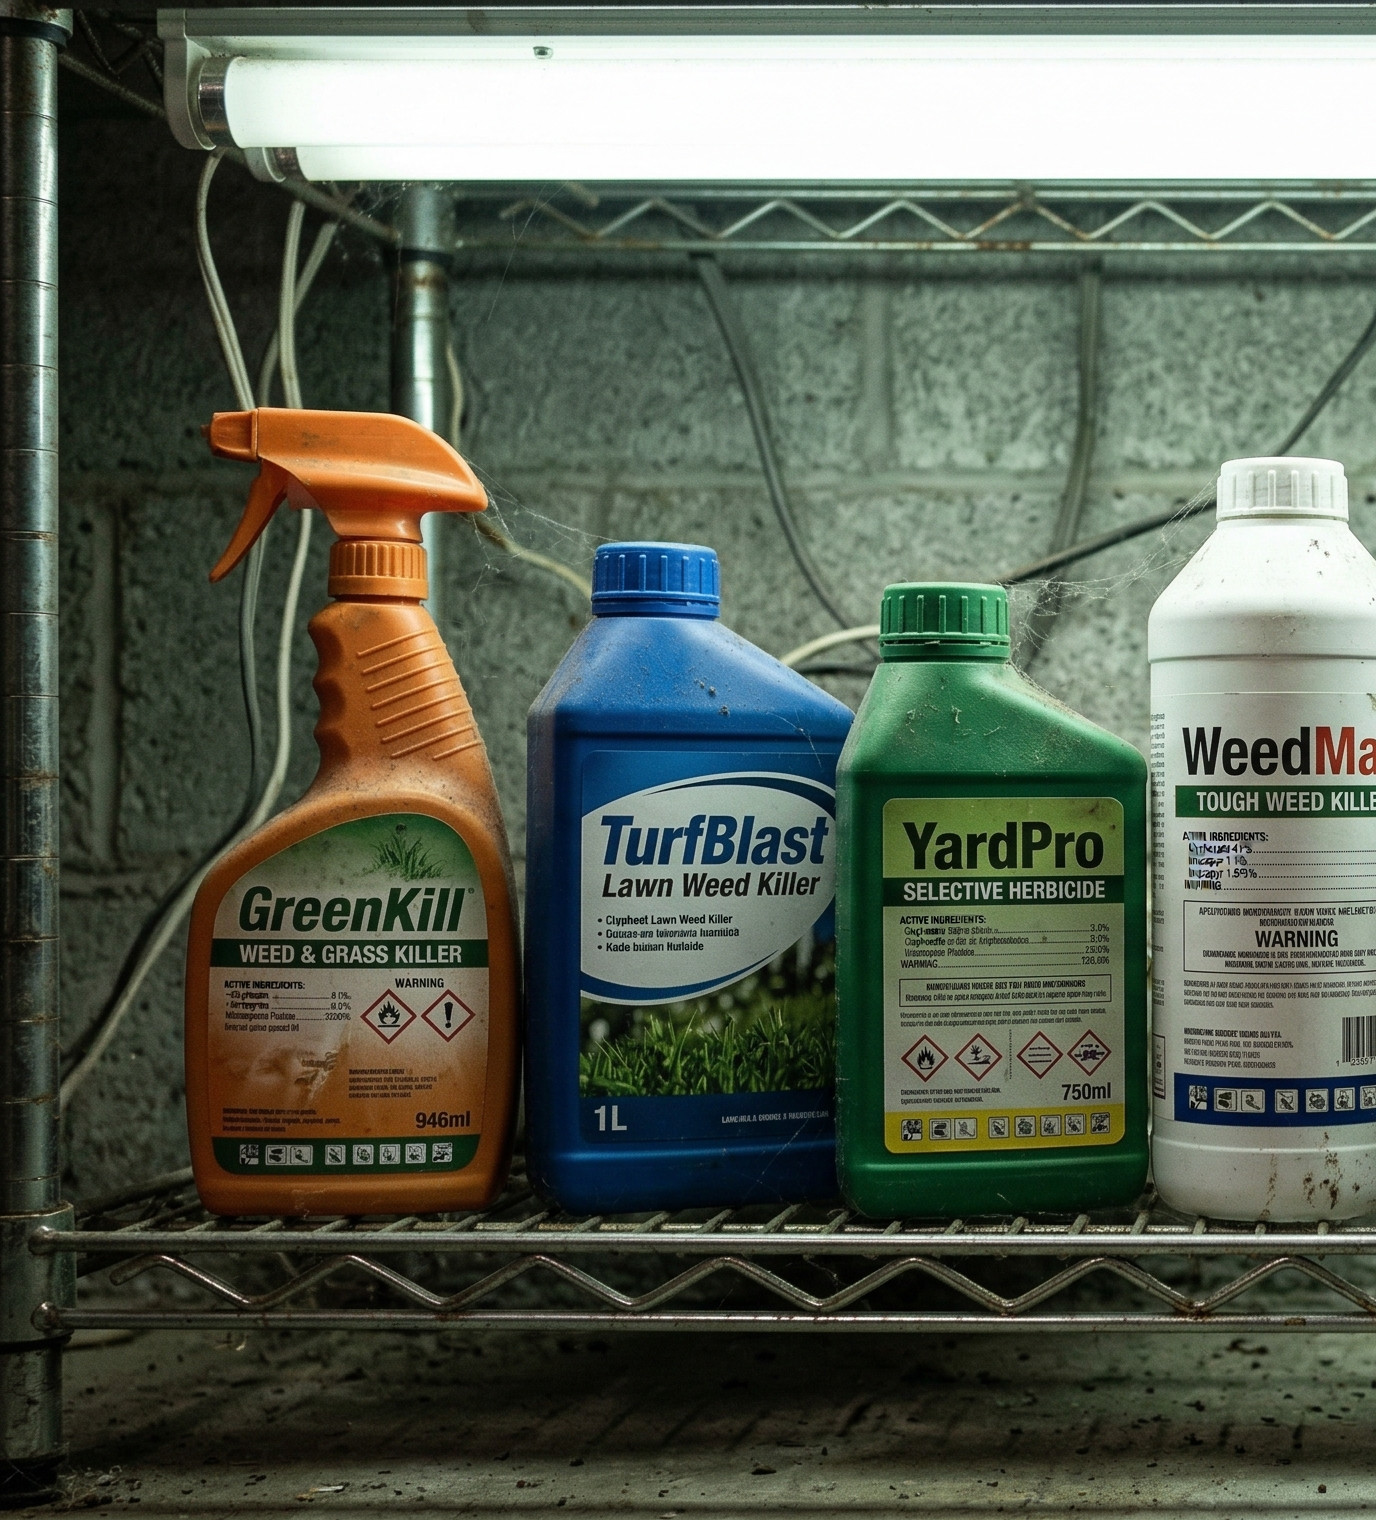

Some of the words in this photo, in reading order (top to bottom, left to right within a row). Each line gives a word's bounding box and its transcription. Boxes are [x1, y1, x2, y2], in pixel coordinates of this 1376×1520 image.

[1196, 791, 1259, 811] TOUGH
[1266, 791, 1324, 811] WEED
[600, 814, 829, 866] TurfBlast
[902, 821, 1105, 870] YardPro
[602, 872, 674, 898] Lawn
[682, 872, 751, 898] Weed
[757, 871, 821, 897] Killer
[903, 881, 1003, 901] SELECTIVE
[1009, 880, 1106, 900] HERBICIDE
[238, 886, 465, 934] GreenKill
[651, 914, 677, 925] Lawn
[679, 914, 706, 924] Weed
[708, 913, 734, 924] Killer
[900, 915, 929, 925] ACTIVE
[1254, 929, 1339, 948] WARNING
[239, 944, 296, 965] WEED
[301, 944, 317, 965] &
[321, 944, 389, 965] GRASS
[395, 944, 462, 965] KILLER
[394, 977, 445, 989] WARNING
[1061, 1082, 1112, 1101] 750ml
[415, 1110, 471, 1129] 946ml
[593, 1104, 628, 1132] 1L
